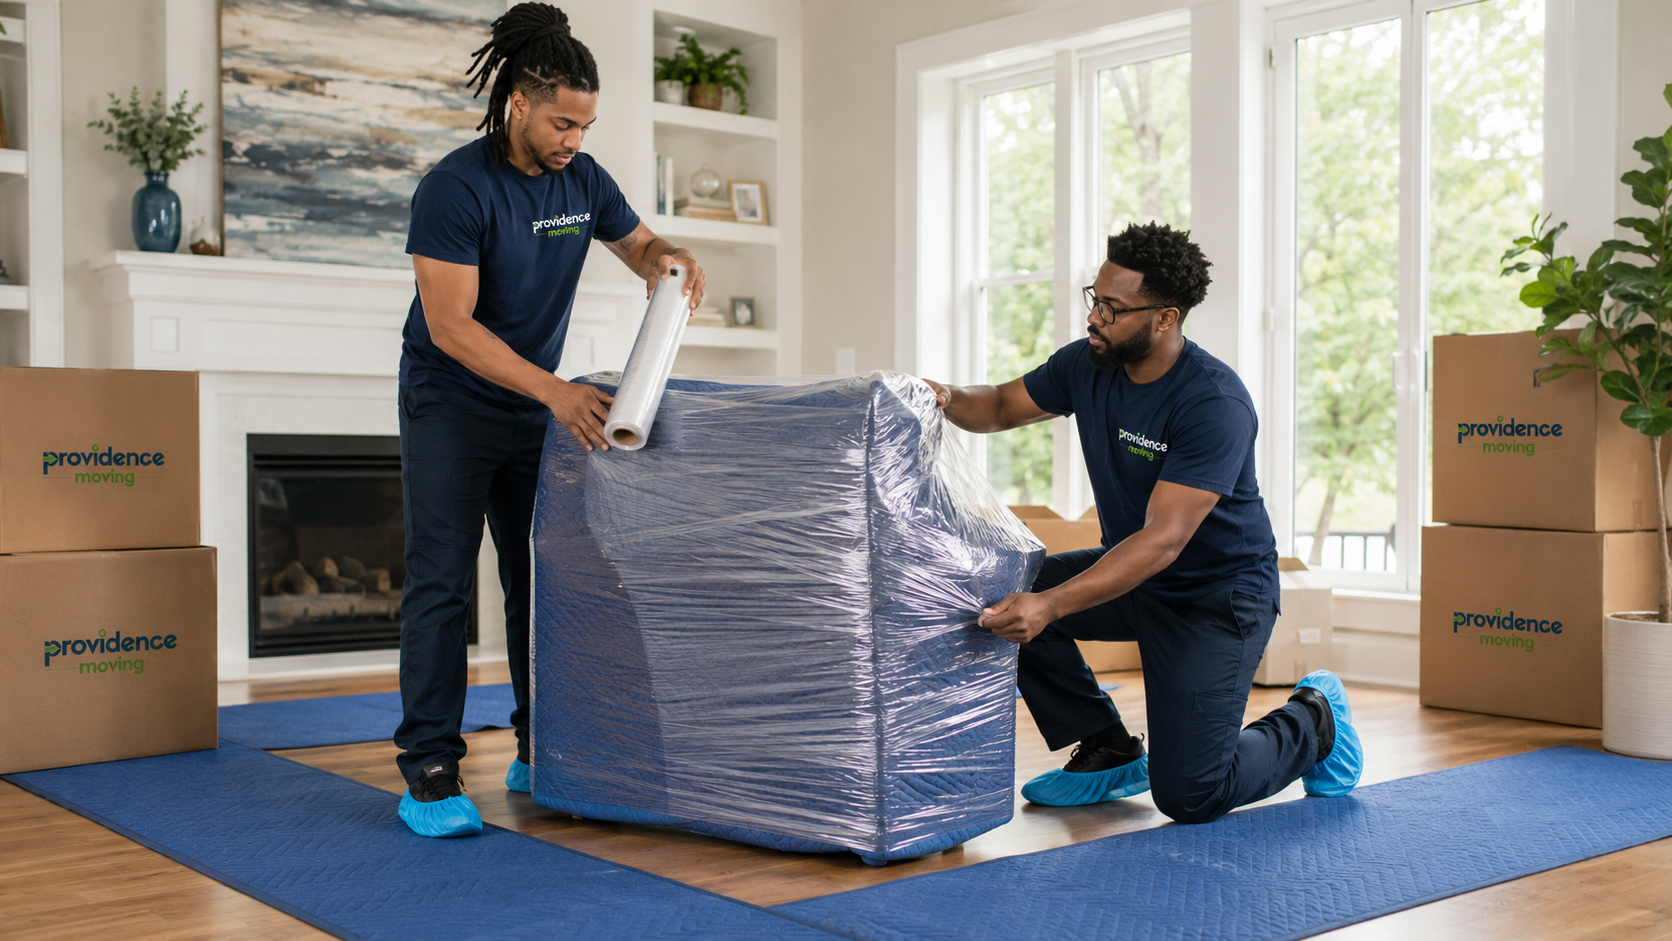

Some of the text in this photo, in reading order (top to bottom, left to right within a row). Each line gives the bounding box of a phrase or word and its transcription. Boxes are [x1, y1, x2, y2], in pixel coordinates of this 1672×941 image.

[532, 212, 591, 234] providence
[1118, 427, 1168, 452] providence
[1458, 415, 1563, 444] providence
[43, 444, 165, 475] providence
[1483, 439, 1535, 457] moving
[75, 469, 135, 487] moving
[1453, 607, 1563, 635] providence
[44, 629, 178, 667] providence
[1480, 633, 1535, 653] moving
[79, 656, 145, 675] moving
